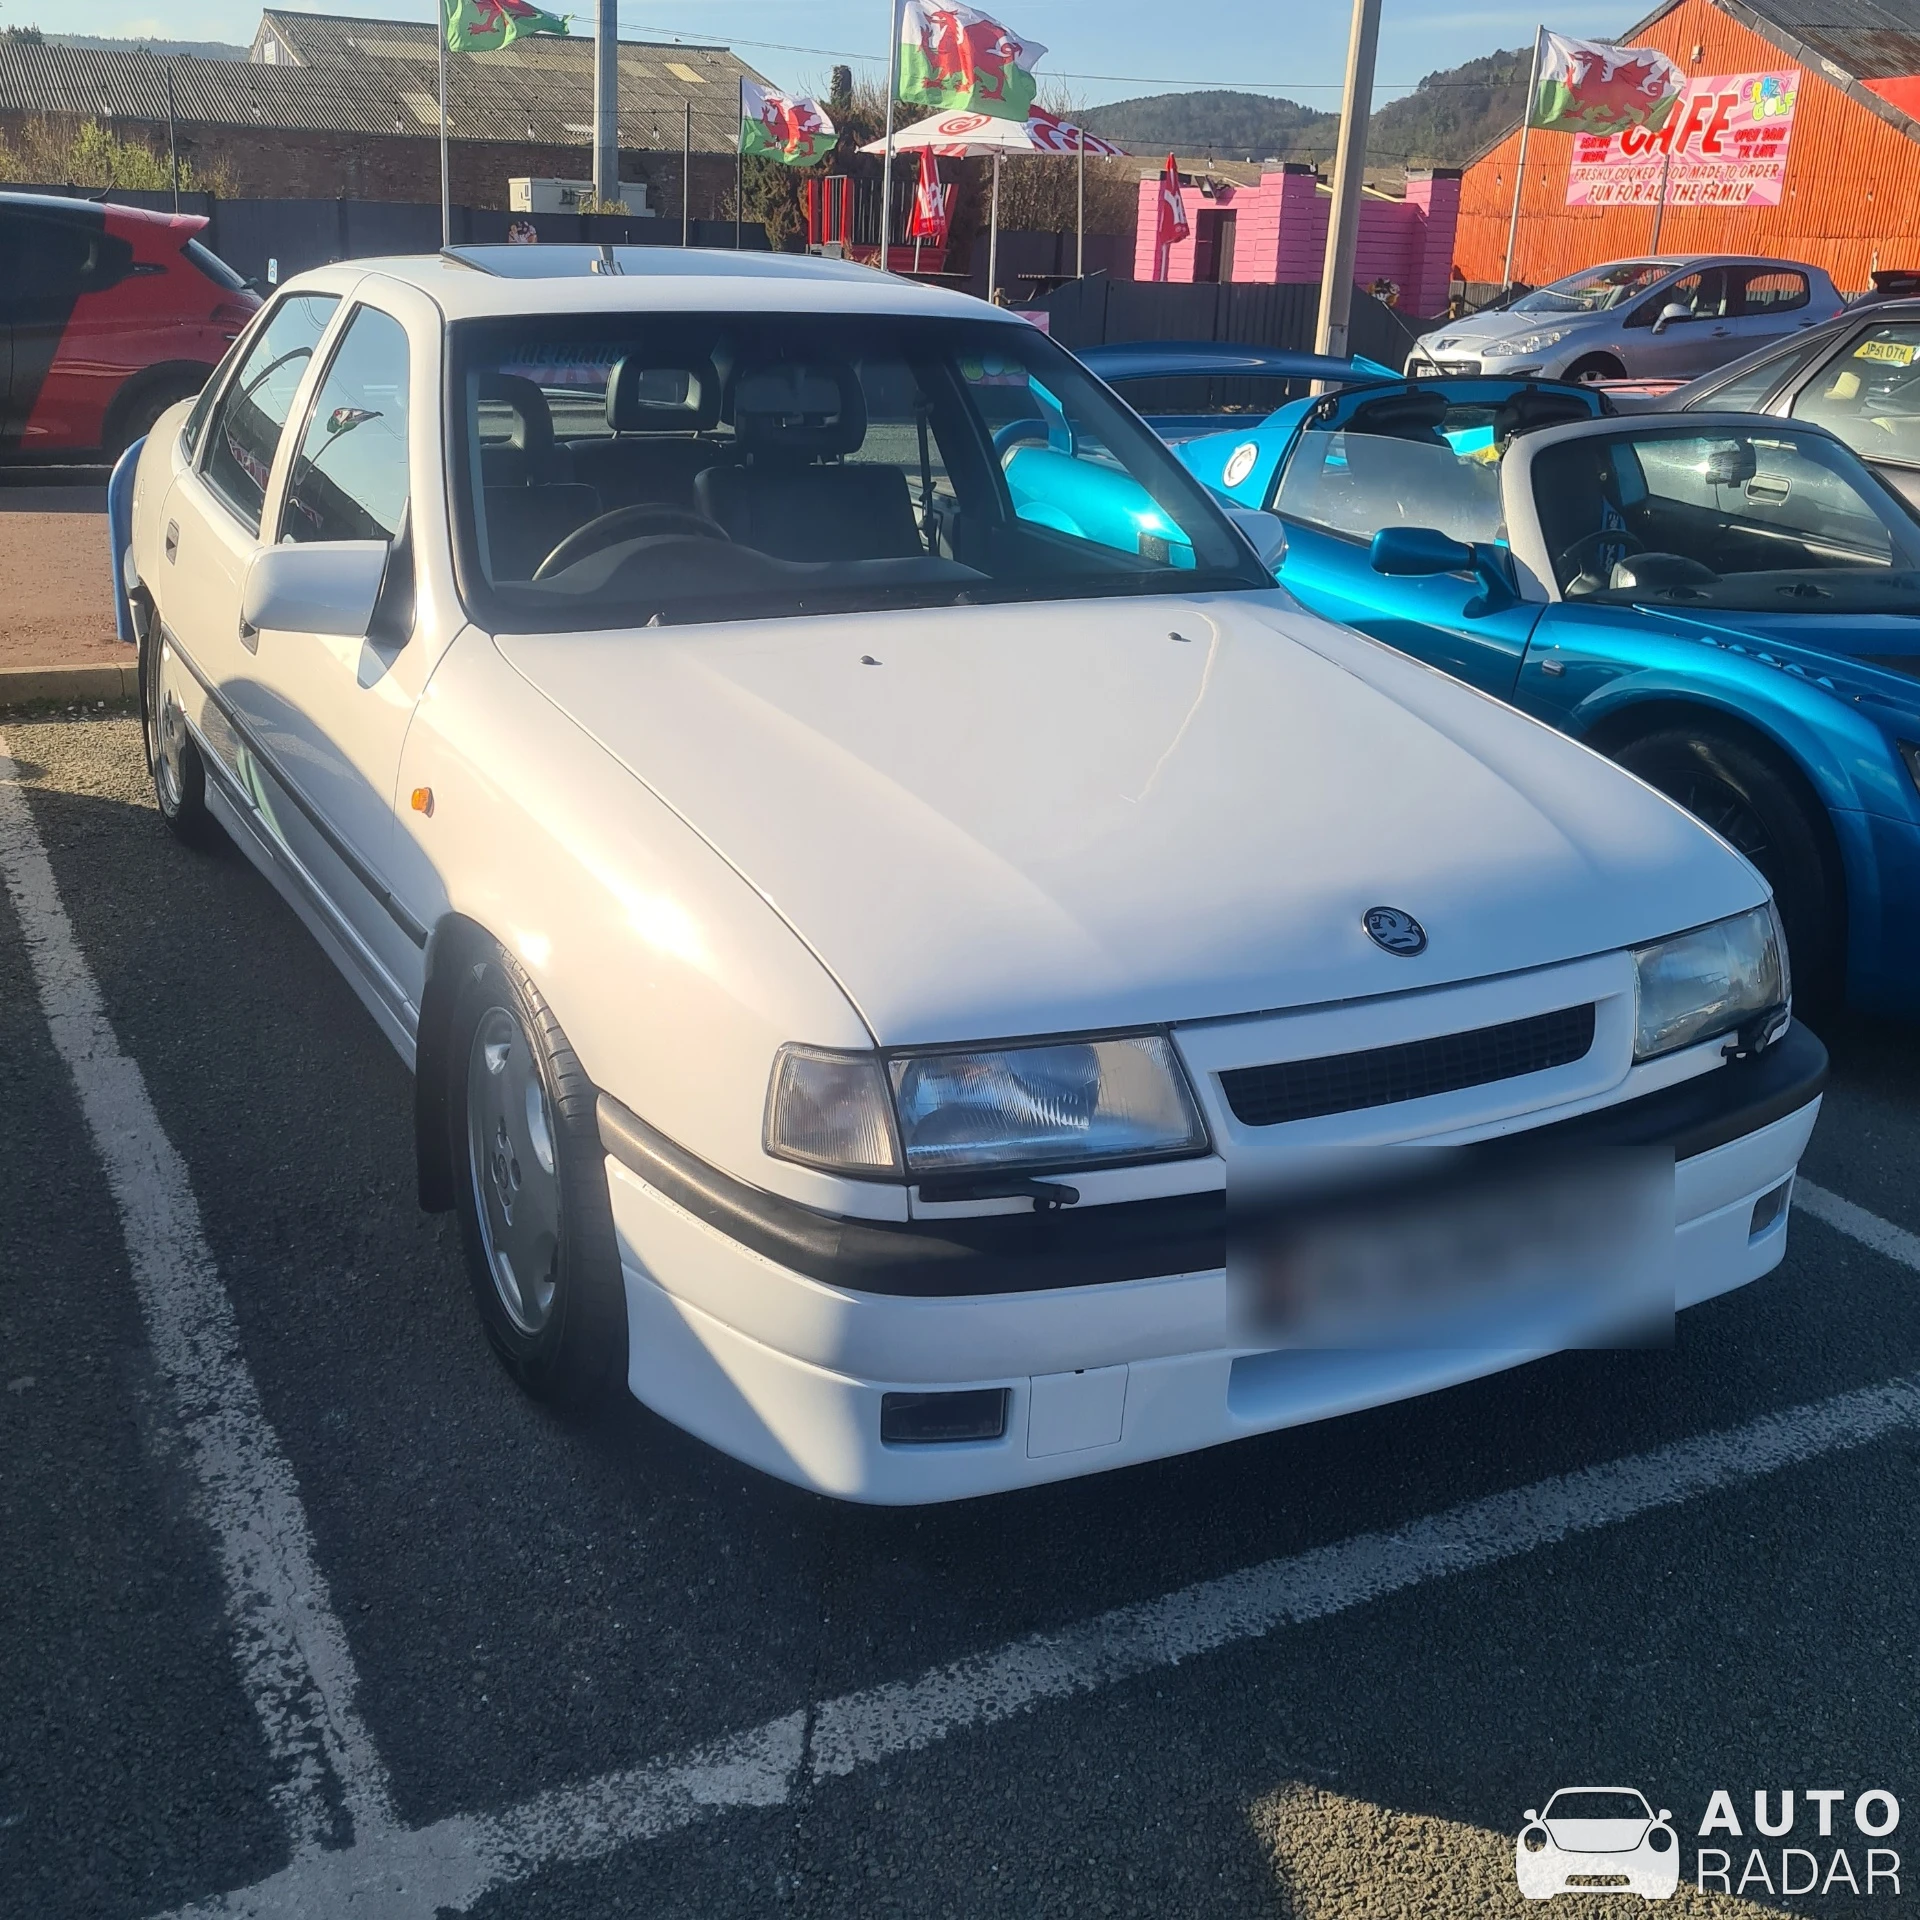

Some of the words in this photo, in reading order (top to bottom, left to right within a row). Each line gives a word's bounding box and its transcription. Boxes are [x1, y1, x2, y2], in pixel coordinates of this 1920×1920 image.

[1741, 76, 1793, 103] CRAZY
[1752, 91, 1796, 121] GOLF
[1734, 128, 1761, 143] OPEN
[1761, 127, 1787, 141] 9AM
[1753, 144, 1777, 158] LATE
[1574, 167, 1613, 181] FRESHLY
[1614, 166, 1656, 180] COOKED
[1688, 165, 1722, 179] MADE
[1724, 165, 1738, 179] TO
[1739, 163, 1780, 178] ORDER
[1588, 184, 1615, 201] FUN
[1616, 183, 1642, 201] FOR
[1644, 183, 1666, 201] AL
[1672, 183, 1699, 201] THE
[1701, 183, 1754, 201] FAMILY
